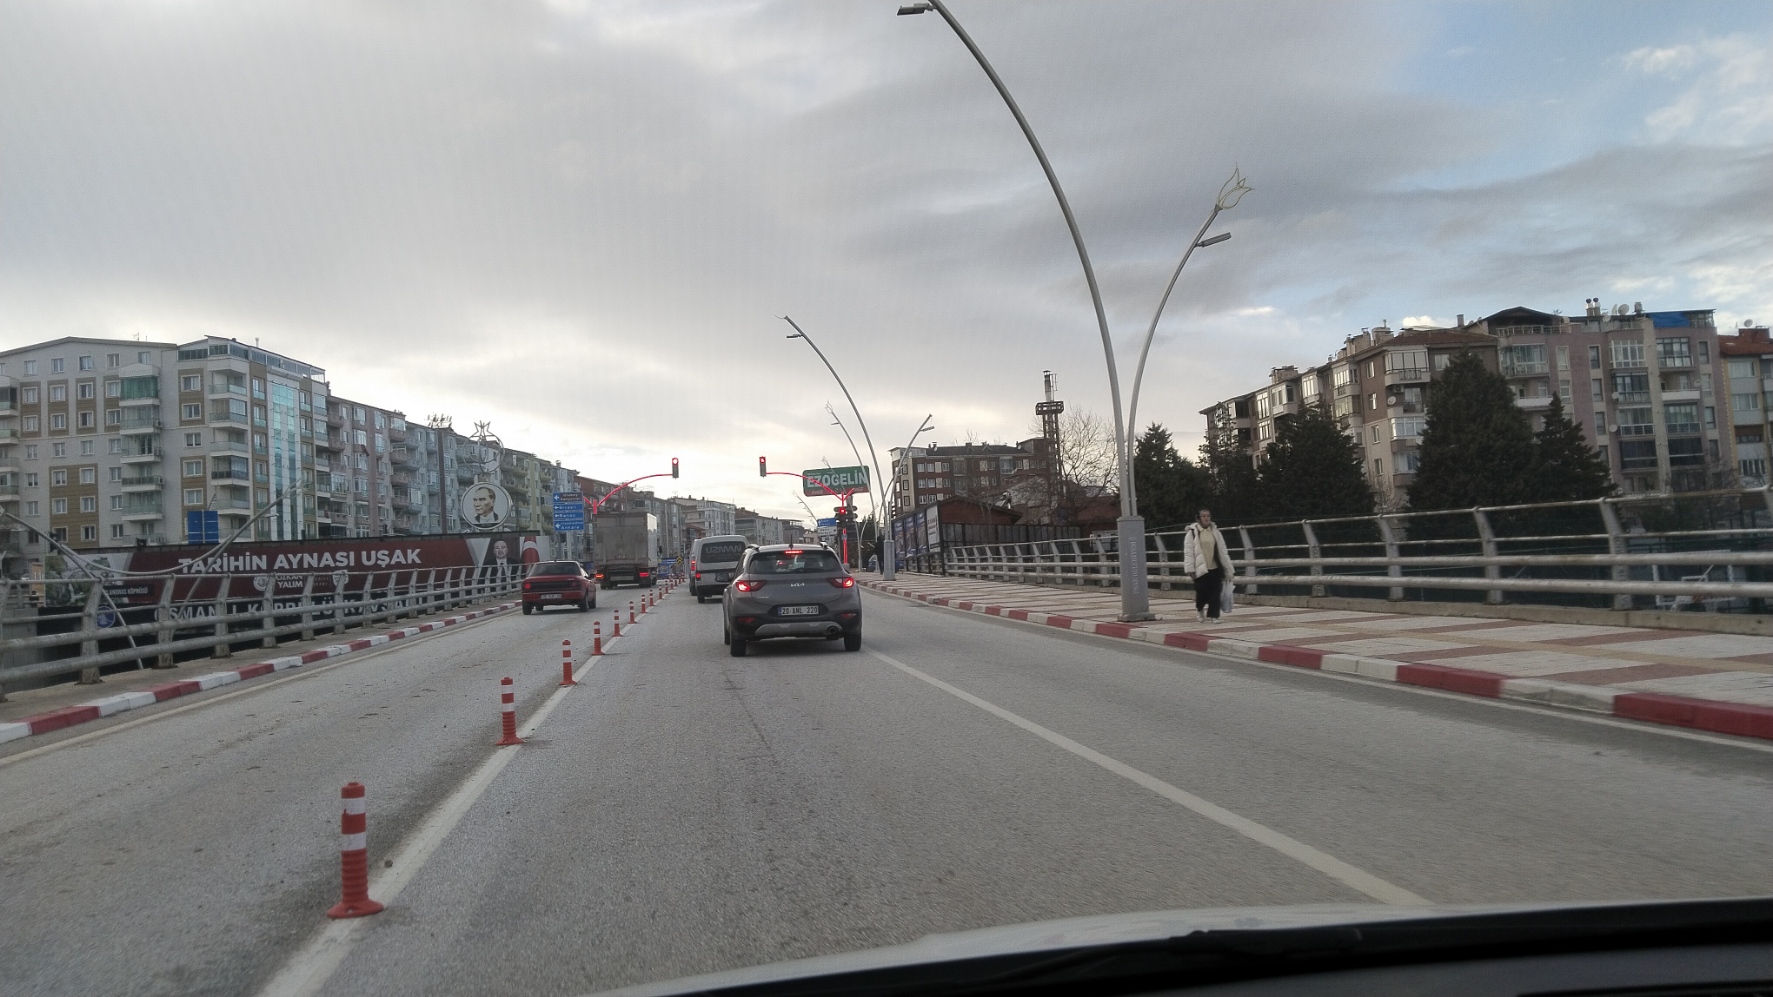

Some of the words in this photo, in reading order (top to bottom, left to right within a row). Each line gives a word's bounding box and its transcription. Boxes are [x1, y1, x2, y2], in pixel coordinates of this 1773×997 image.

[807, 469, 867, 488] EZOGELİN
[178, 552, 267, 574] TARİHİN
[273, 551, 355, 569] AYNASI
[361, 548, 422, 568] UŞAK
[277, 581, 304, 589] YALIM
[806, 606, 818, 614] 220
